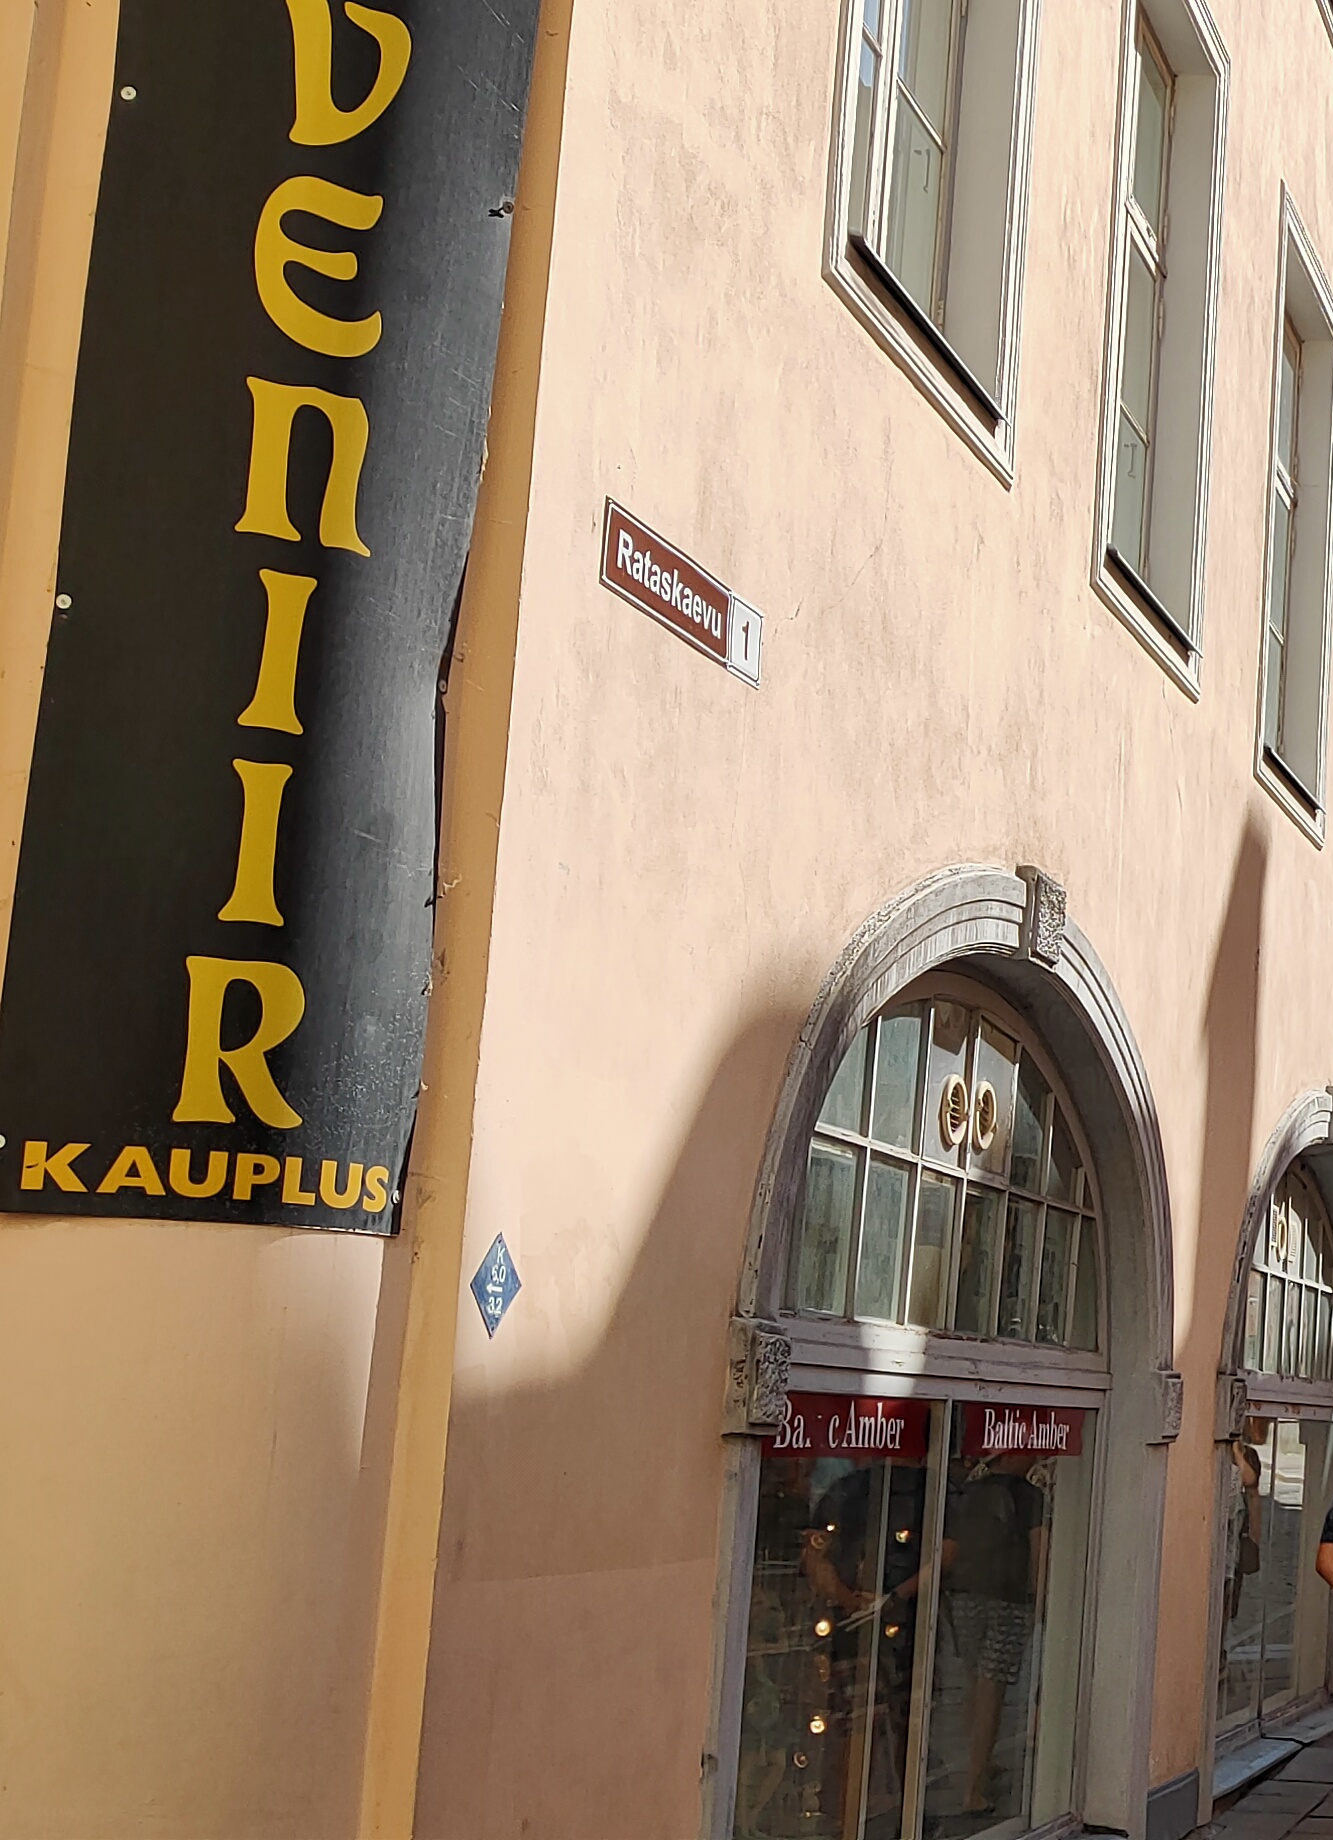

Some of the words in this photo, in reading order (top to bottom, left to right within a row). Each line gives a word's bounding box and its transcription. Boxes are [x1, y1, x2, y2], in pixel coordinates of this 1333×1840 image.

[617, 529, 722, 639] Rataskaevu
[741, 620, 750, 661] 1
[20, 1140, 391, 1213] KAUPLUS
[497, 1246, 506, 1264] K
[842, 1400, 905, 1450] Amber
[982, 1408, 1027, 1450] Baltic
[1028, 1409, 1070, 1450] Amber
